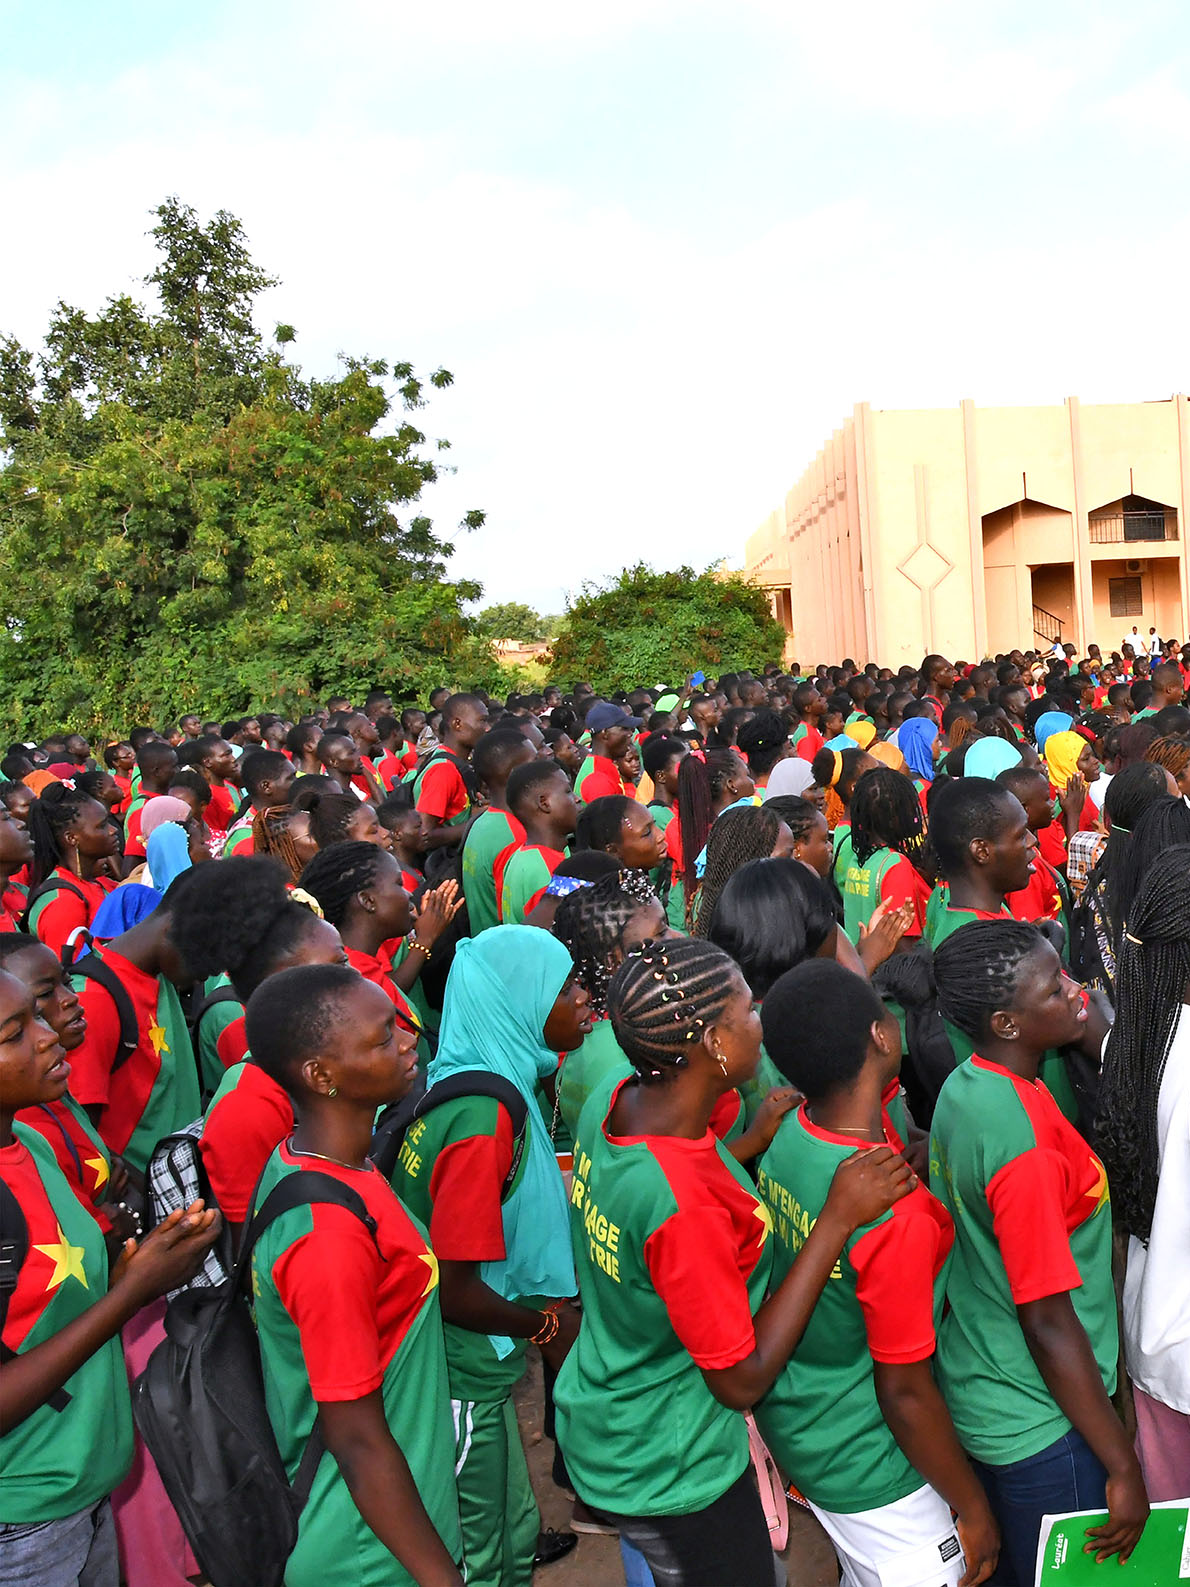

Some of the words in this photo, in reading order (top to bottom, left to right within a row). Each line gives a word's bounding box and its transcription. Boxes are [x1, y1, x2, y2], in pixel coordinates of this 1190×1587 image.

[768, 1178, 818, 1238] M'ENGA
[590, 1236, 621, 1283] TRIE
[1051, 1533, 1064, 1569] Lauréat
